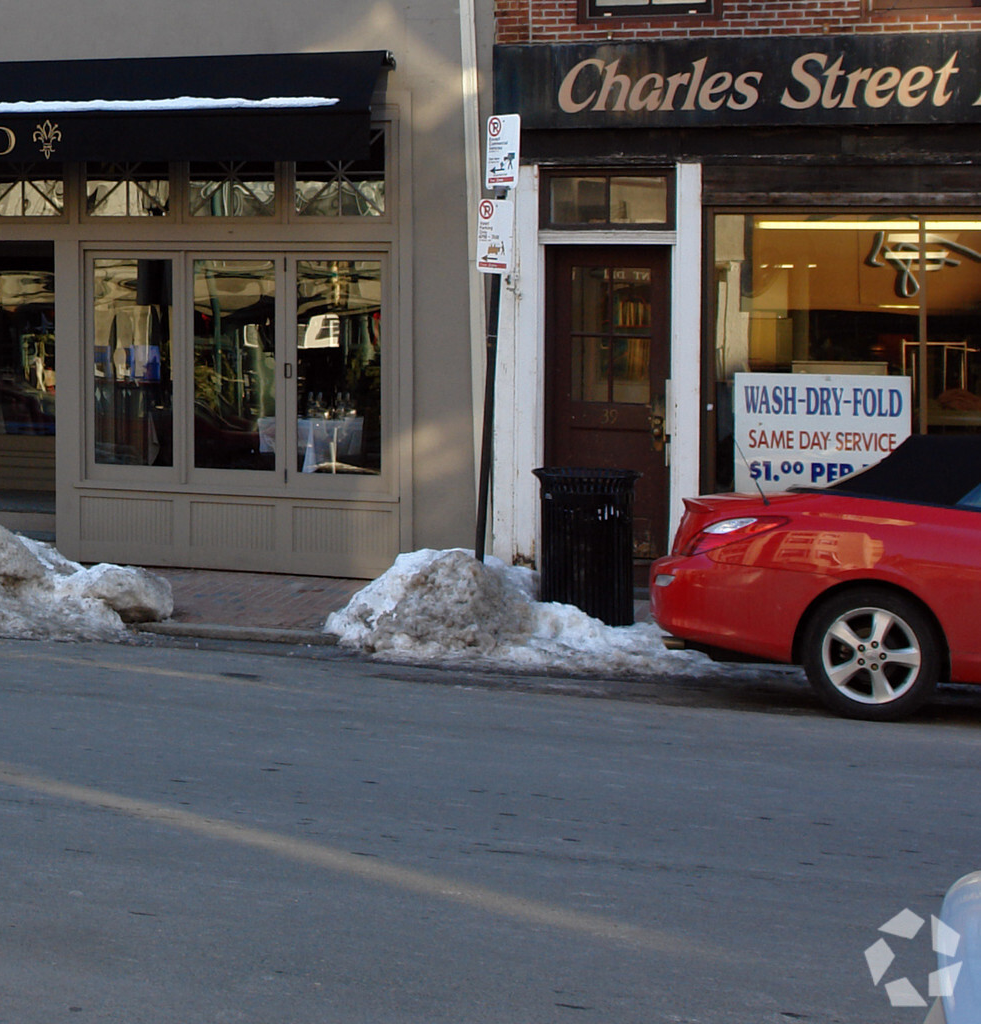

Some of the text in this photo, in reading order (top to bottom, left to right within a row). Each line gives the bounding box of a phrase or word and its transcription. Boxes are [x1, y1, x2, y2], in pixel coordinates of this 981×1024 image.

[558, 55, 763, 114] Charles
[780, 50, 960, 111] Street
[744, 386, 903, 417] WASH-DRY-FOLD
[602, 408, 619, 425] 39
[748, 429, 897, 452] SAME DAY SERVICE
